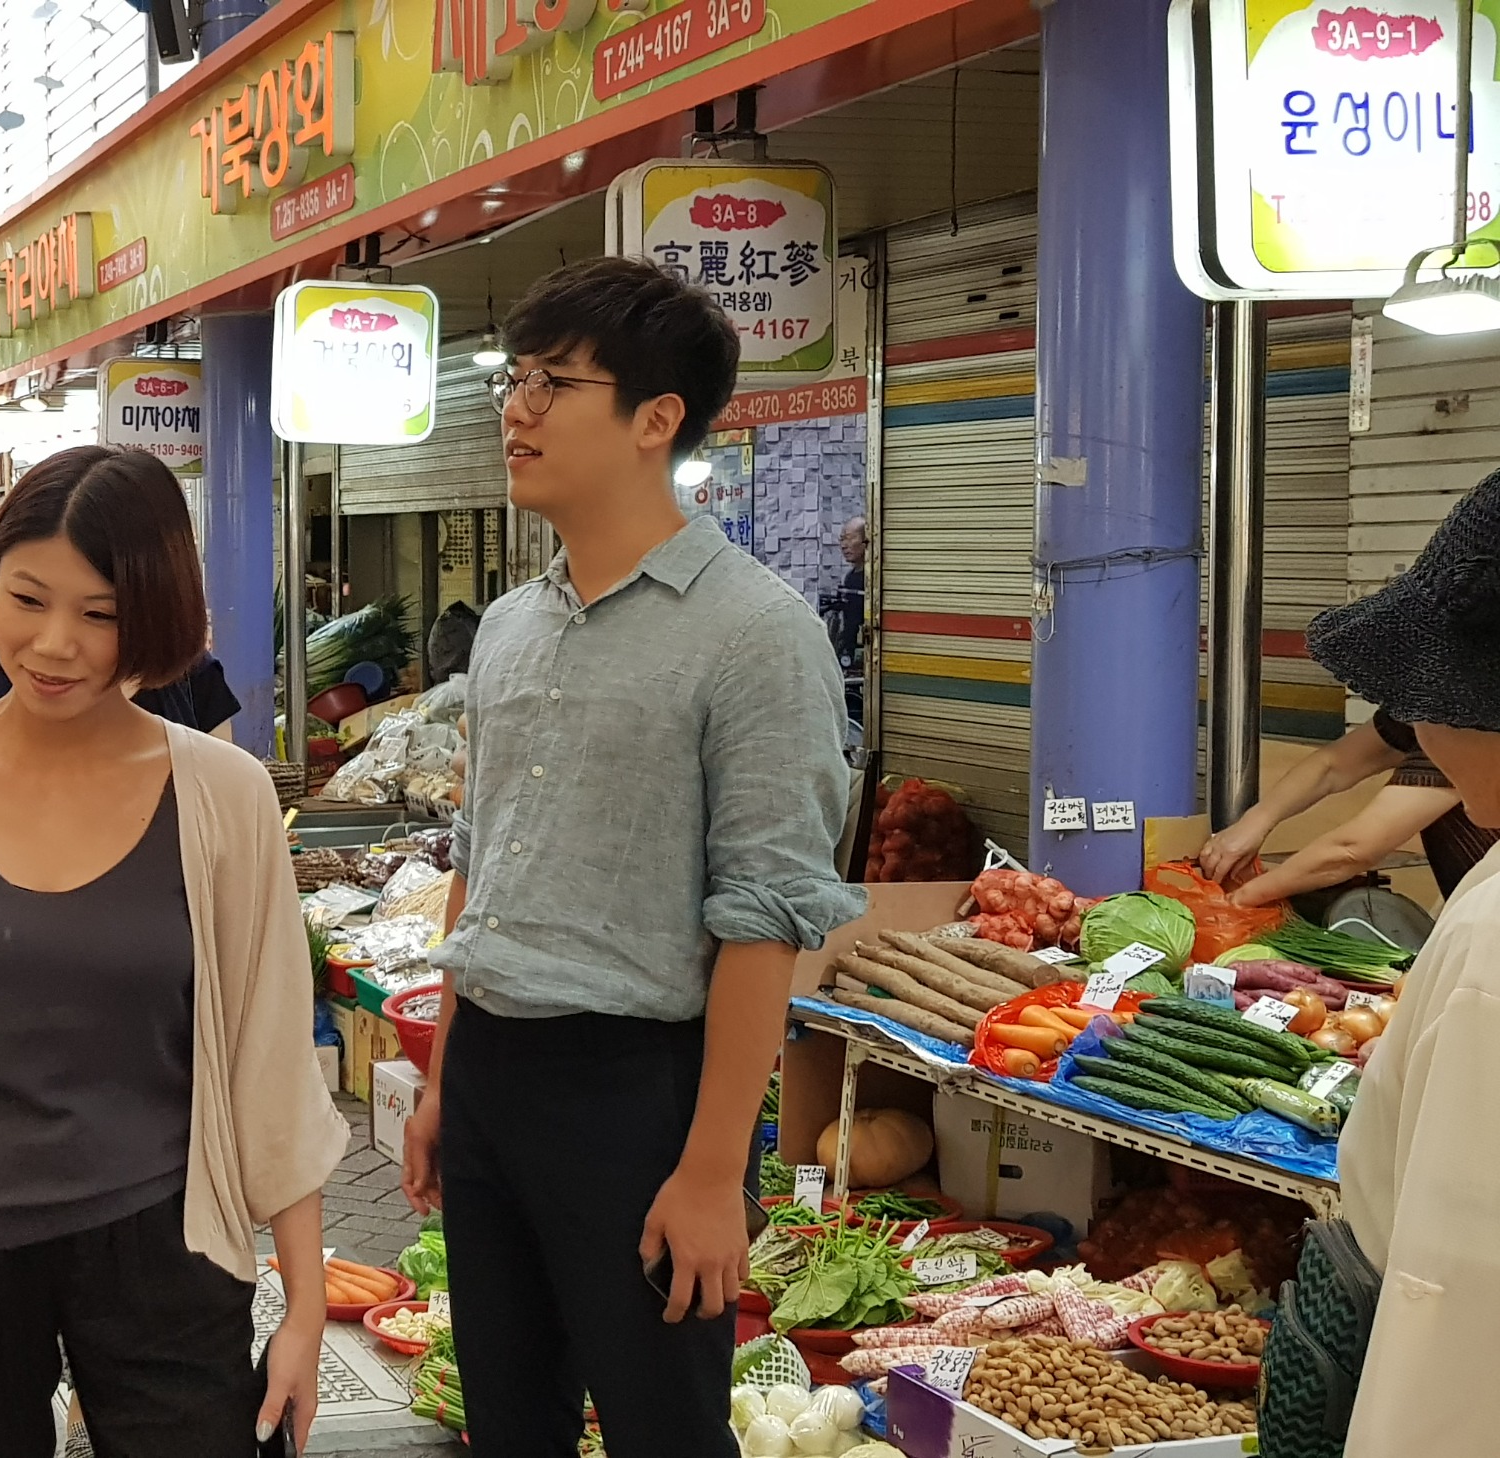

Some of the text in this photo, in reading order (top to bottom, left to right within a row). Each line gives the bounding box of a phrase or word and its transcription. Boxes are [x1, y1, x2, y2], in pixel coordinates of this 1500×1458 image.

[603, 10, 693, 85] T.244-4167
[1327, 20, 1417, 50] 3A-9-1
[189, 31, 334, 215] 거북상회
[275, 173, 348, 231] T.257-8356 3A-7
[712, 203, 757, 224] 3A-8
[343, 314, 379, 330] 3A-7
[140, 382, 178, 393] 3A-6-1
[788, 385, 857, 415] 257-8356
[122, 405, 200, 433] 미자야채
